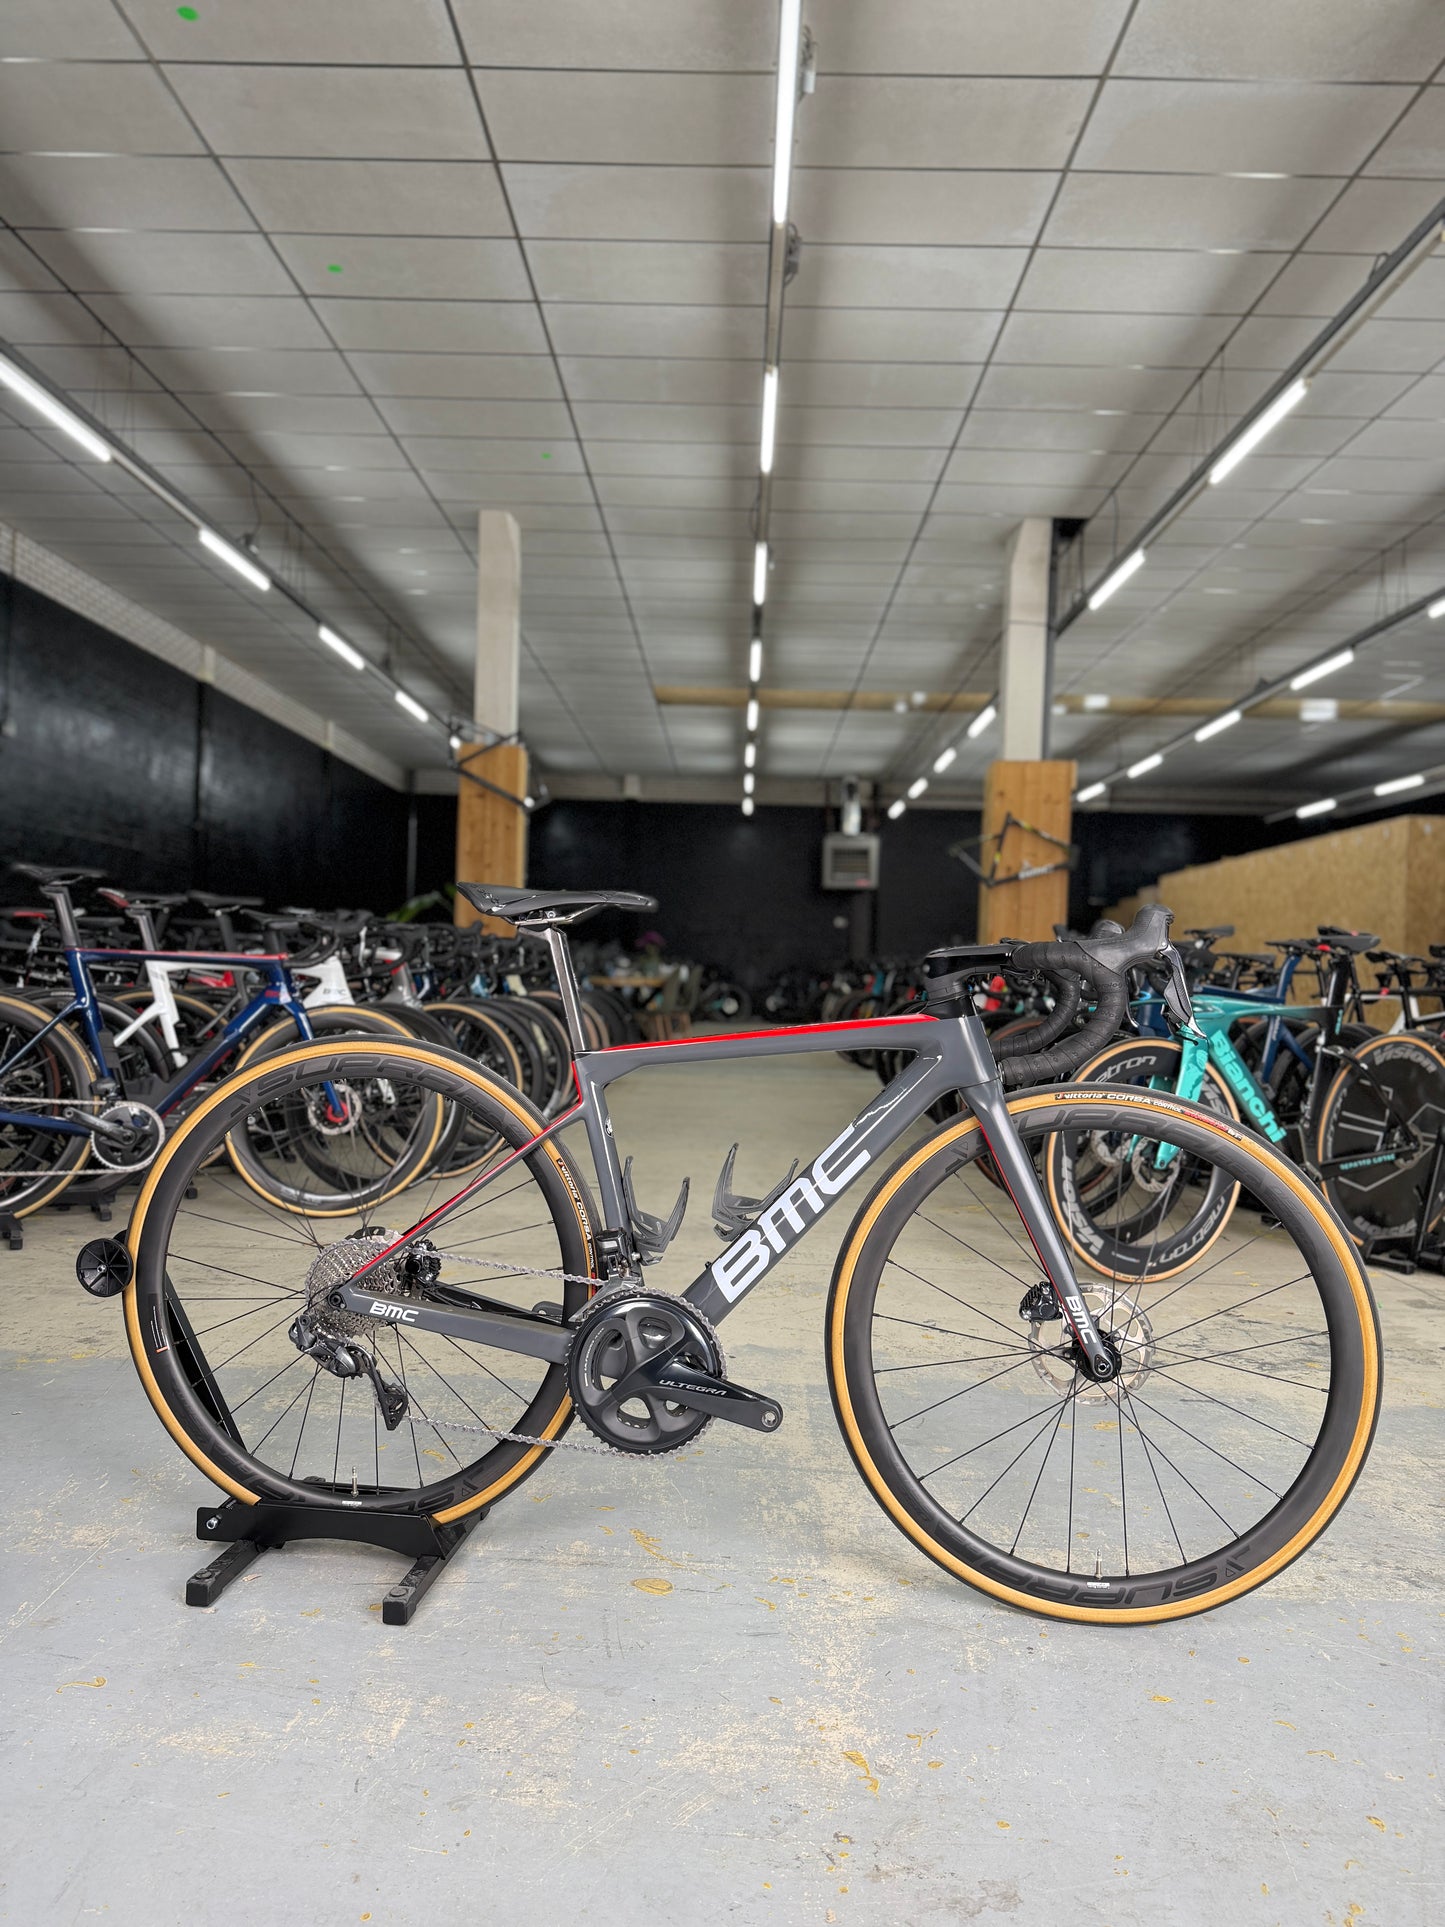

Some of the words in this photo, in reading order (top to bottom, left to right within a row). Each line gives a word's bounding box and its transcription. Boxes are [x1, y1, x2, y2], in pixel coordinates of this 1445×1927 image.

[1095, 1055, 1157, 1083] etron
[1211, 1030, 1288, 1143] Bianchi
[1106, 1093, 1151, 1104] CORSA
[1011, 1108, 1214, 1151] UPRA
[560, 1165, 579, 1200] vittoria
[576, 1201, 591, 1241] CORSA
[711, 1125, 871, 1304] BMC
[1159, 1195, 1226, 1264] metron
[369, 1301, 420, 1323] BMC
[1065, 1295, 1097, 1344] BMC
[658, 1379, 728, 1396] ULTEGRA
